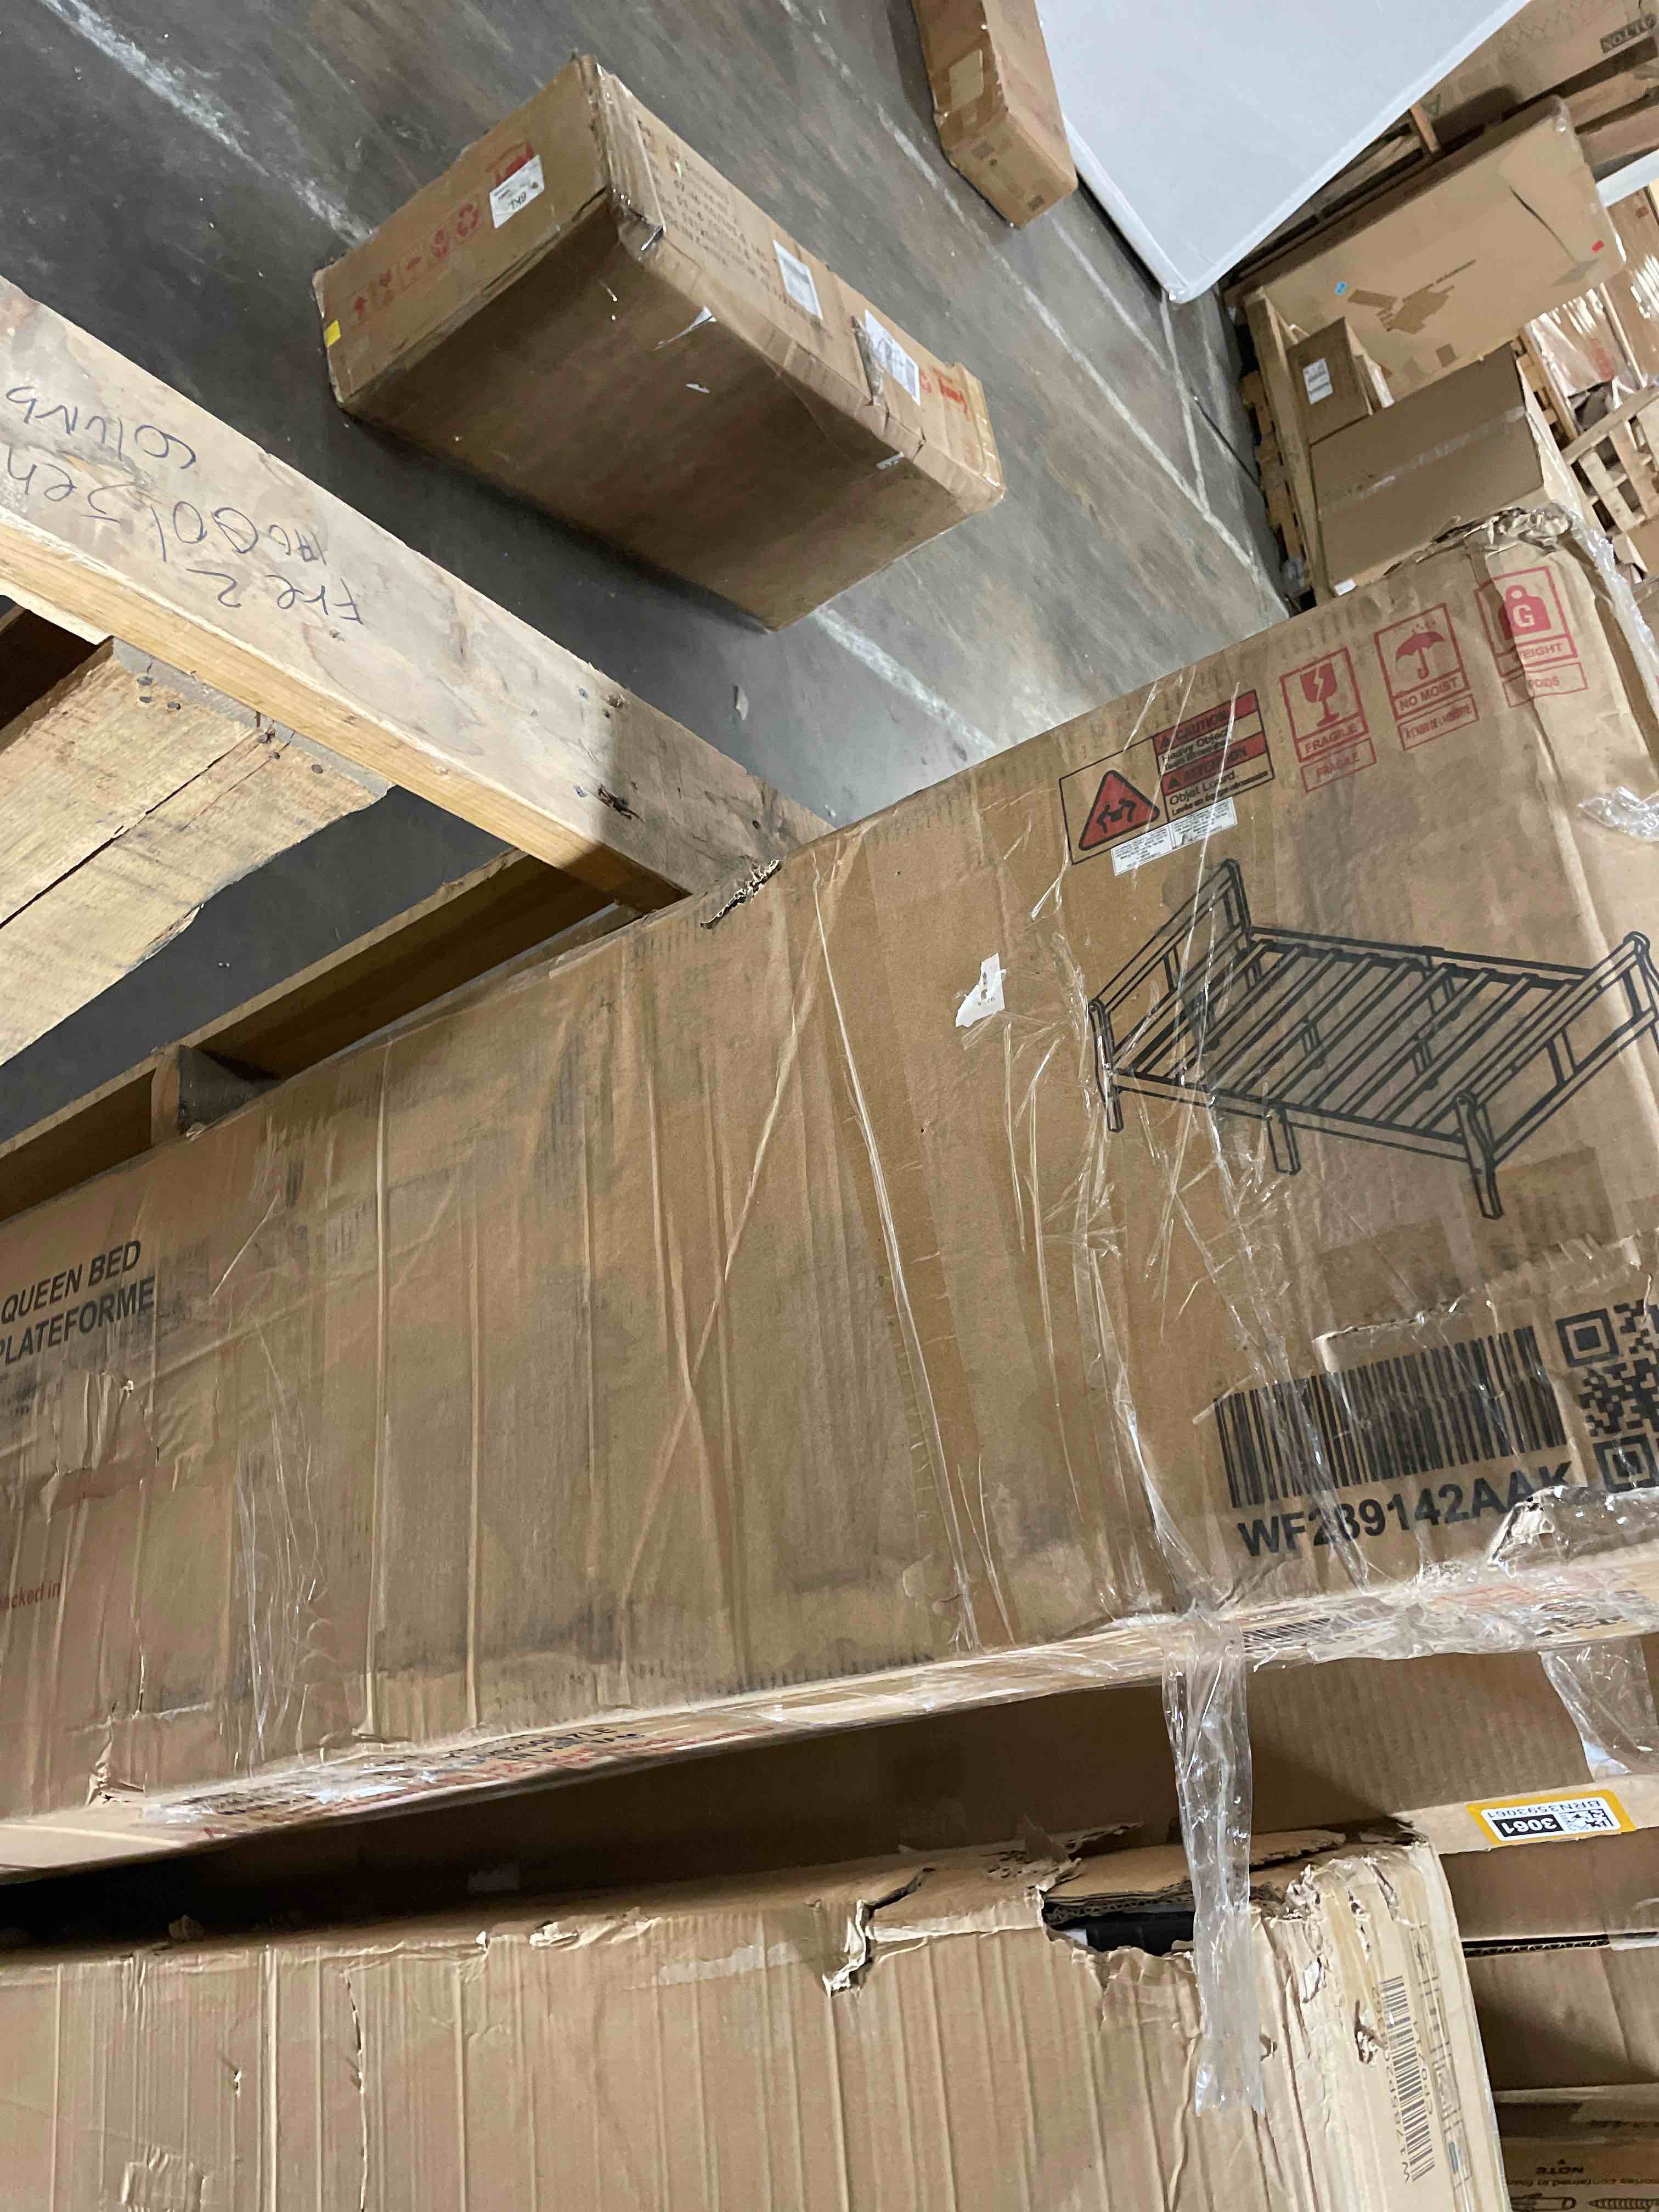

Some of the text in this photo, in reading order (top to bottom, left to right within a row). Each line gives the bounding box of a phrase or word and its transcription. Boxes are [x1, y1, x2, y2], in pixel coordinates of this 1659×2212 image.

[1400, 677, 1458, 710] NO MOIST
[1305, 723, 1358, 754] FRAGILE
[1169, 788, 1200, 806] Objet
[2, 1240, 141, 1324] QUEEN BED
[1500, 1817, 1557, 1835] 3061
[1536, 2166, 1584, 2175] NOTE
